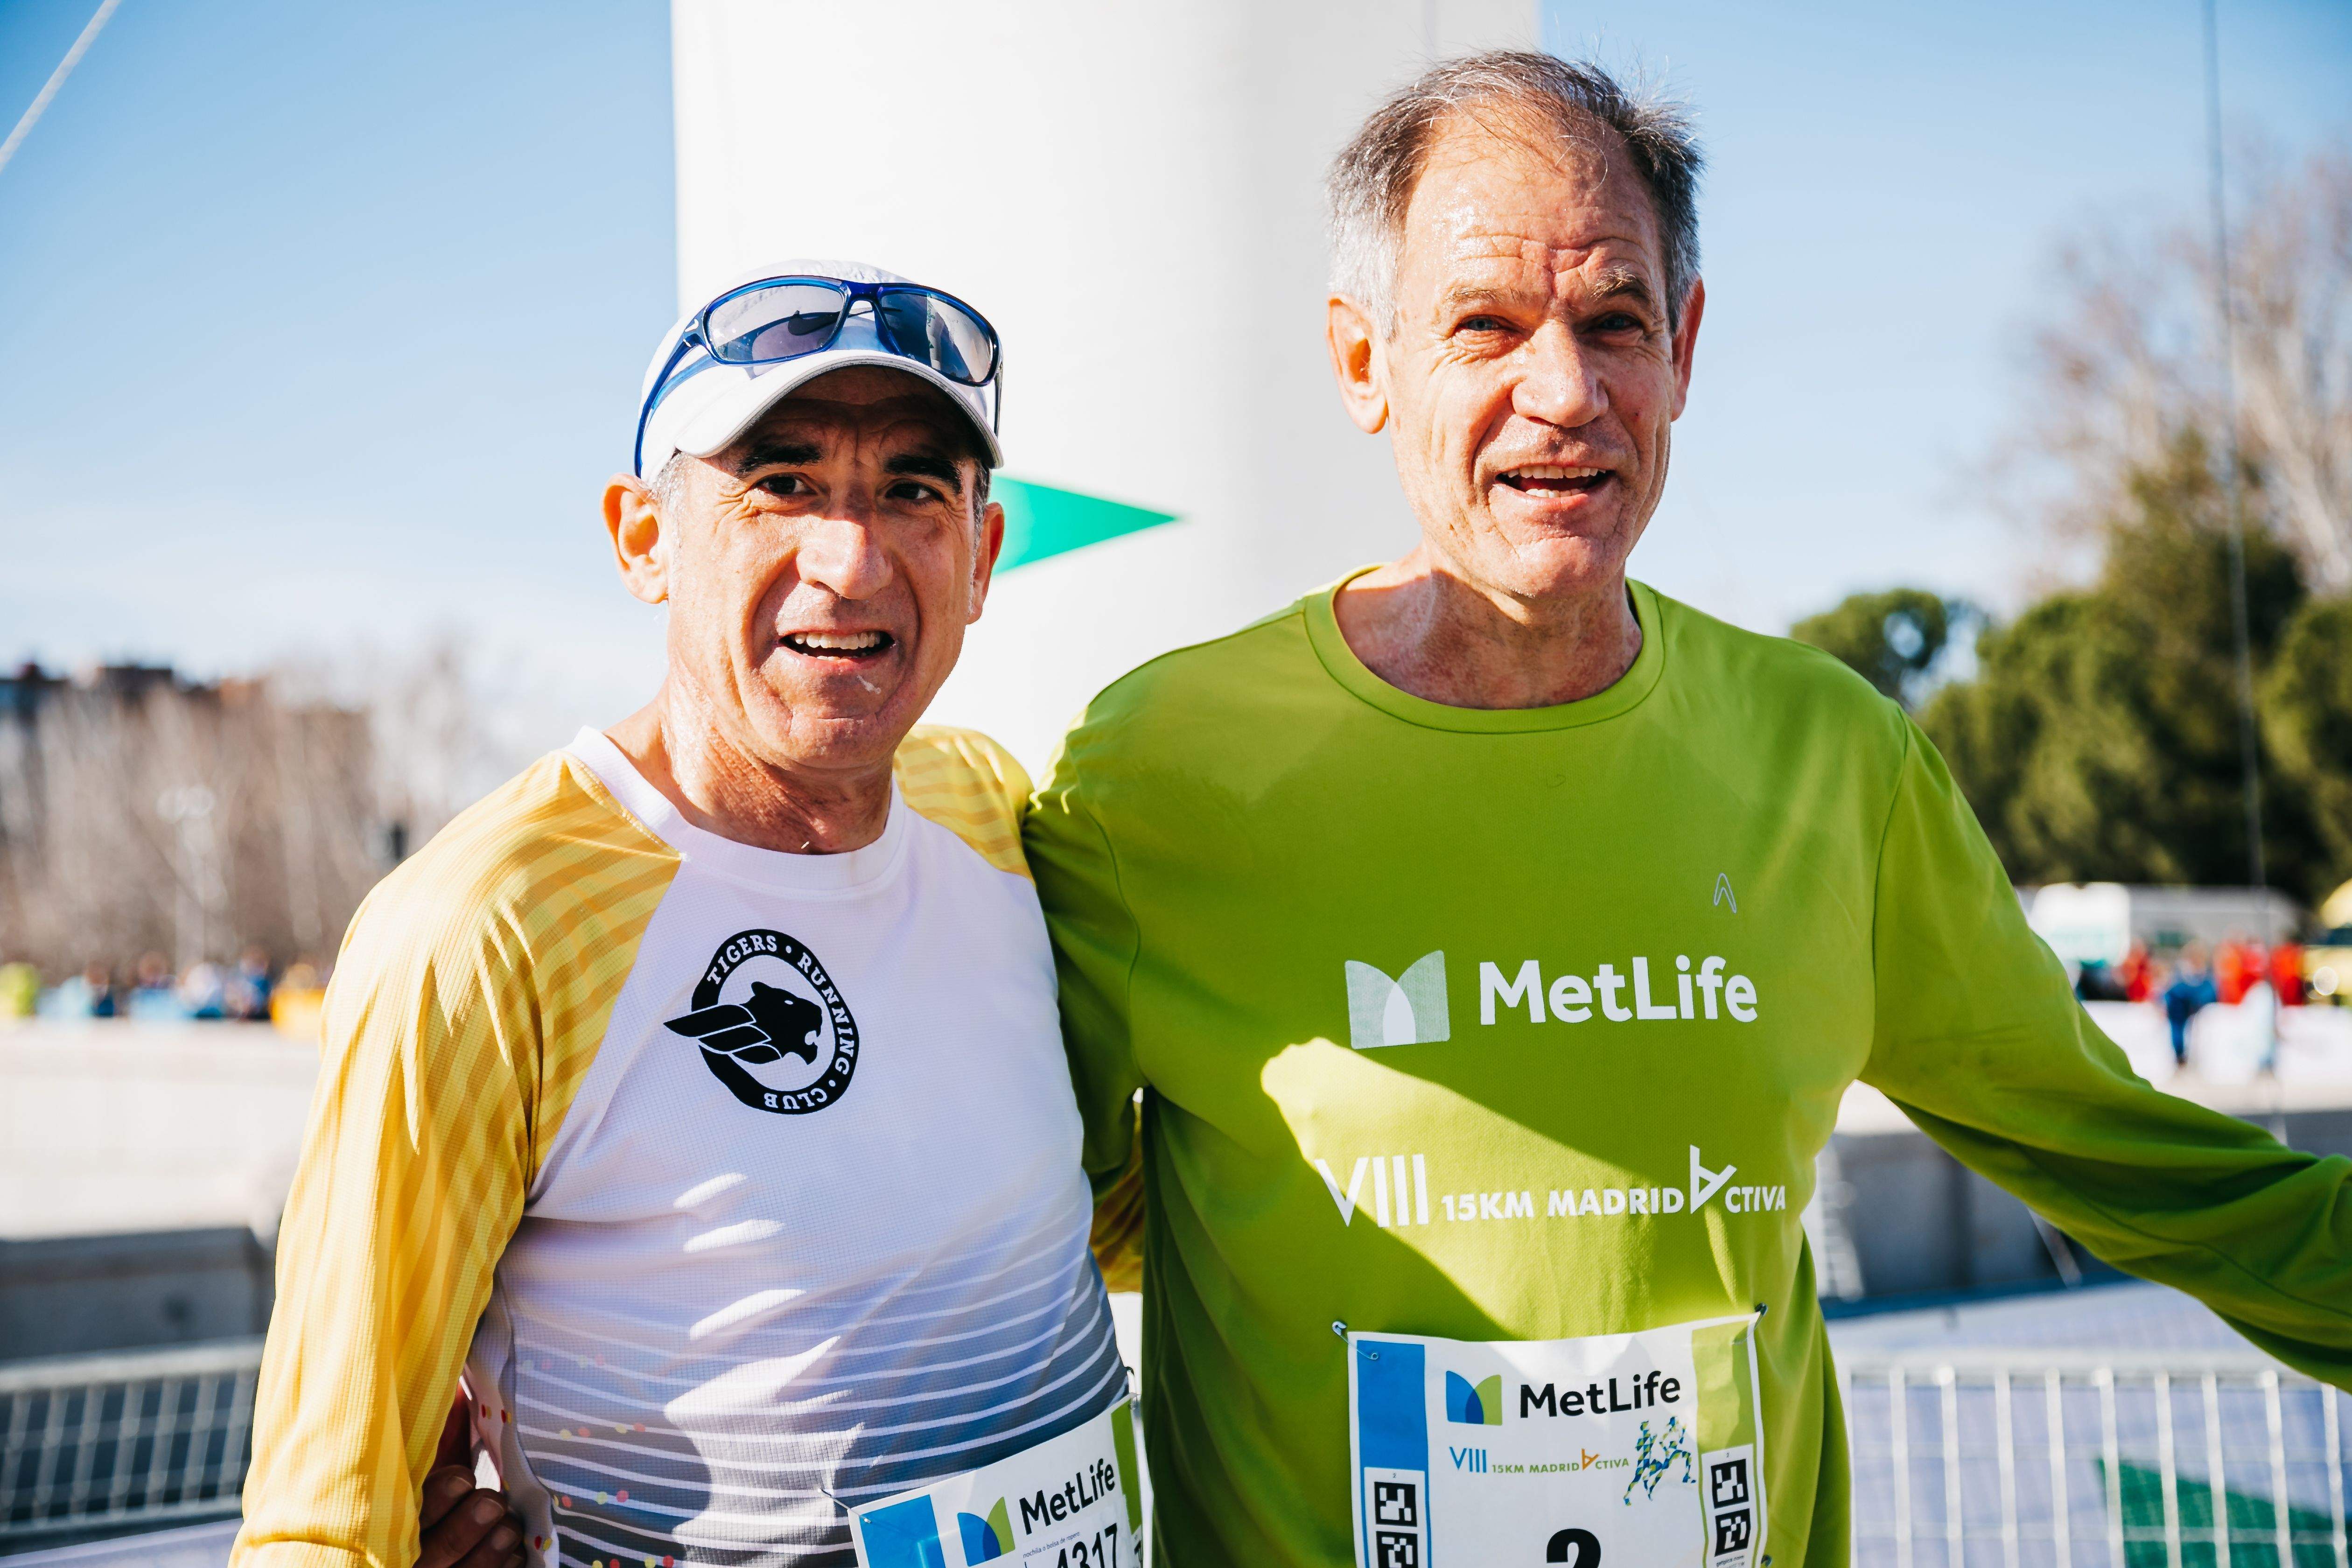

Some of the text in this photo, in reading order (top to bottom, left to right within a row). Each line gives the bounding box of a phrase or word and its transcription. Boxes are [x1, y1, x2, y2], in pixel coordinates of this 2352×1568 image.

[707, 935, 854, 1109] TIGERS RUNNING CLUB
[1479, 955, 1757, 1025] MetLife
[1314, 1154, 1429, 1227] VIII
[1441, 1190, 1532, 1222] 15KM
[1547, 1186, 1684, 1218] MADRID
[1520, 1370, 1680, 1418] MetLife
[1449, 1447, 1487, 1473] VIII
[1492, 1464, 1524, 1473] 15KM
[1529, 1463, 1580, 1473] MADRID
[1019, 1458, 1115, 1535] MetLife
[1046, 1540, 1059, 1549] bolsa
